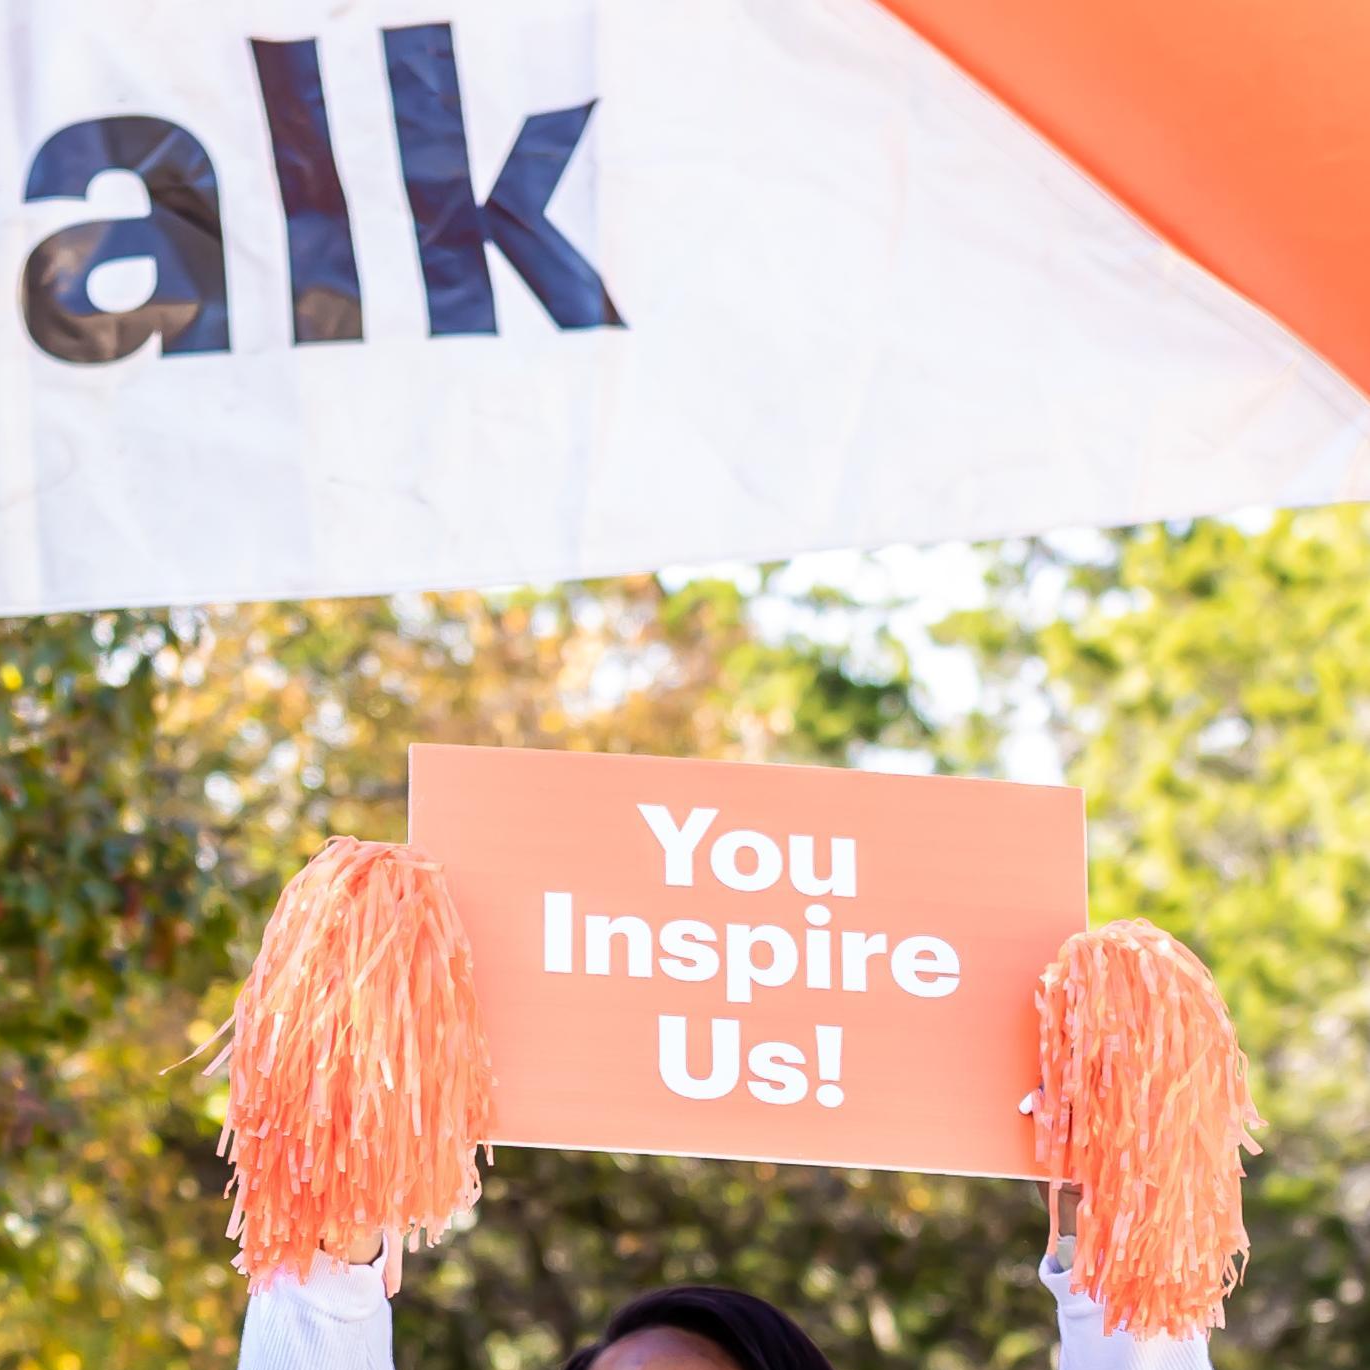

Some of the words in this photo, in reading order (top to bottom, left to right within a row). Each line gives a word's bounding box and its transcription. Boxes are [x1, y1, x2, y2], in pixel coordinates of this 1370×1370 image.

[637, 804, 857, 897] You
[543, 891, 961, 1003] Inspire
[658, 1014, 845, 1108] Us!
